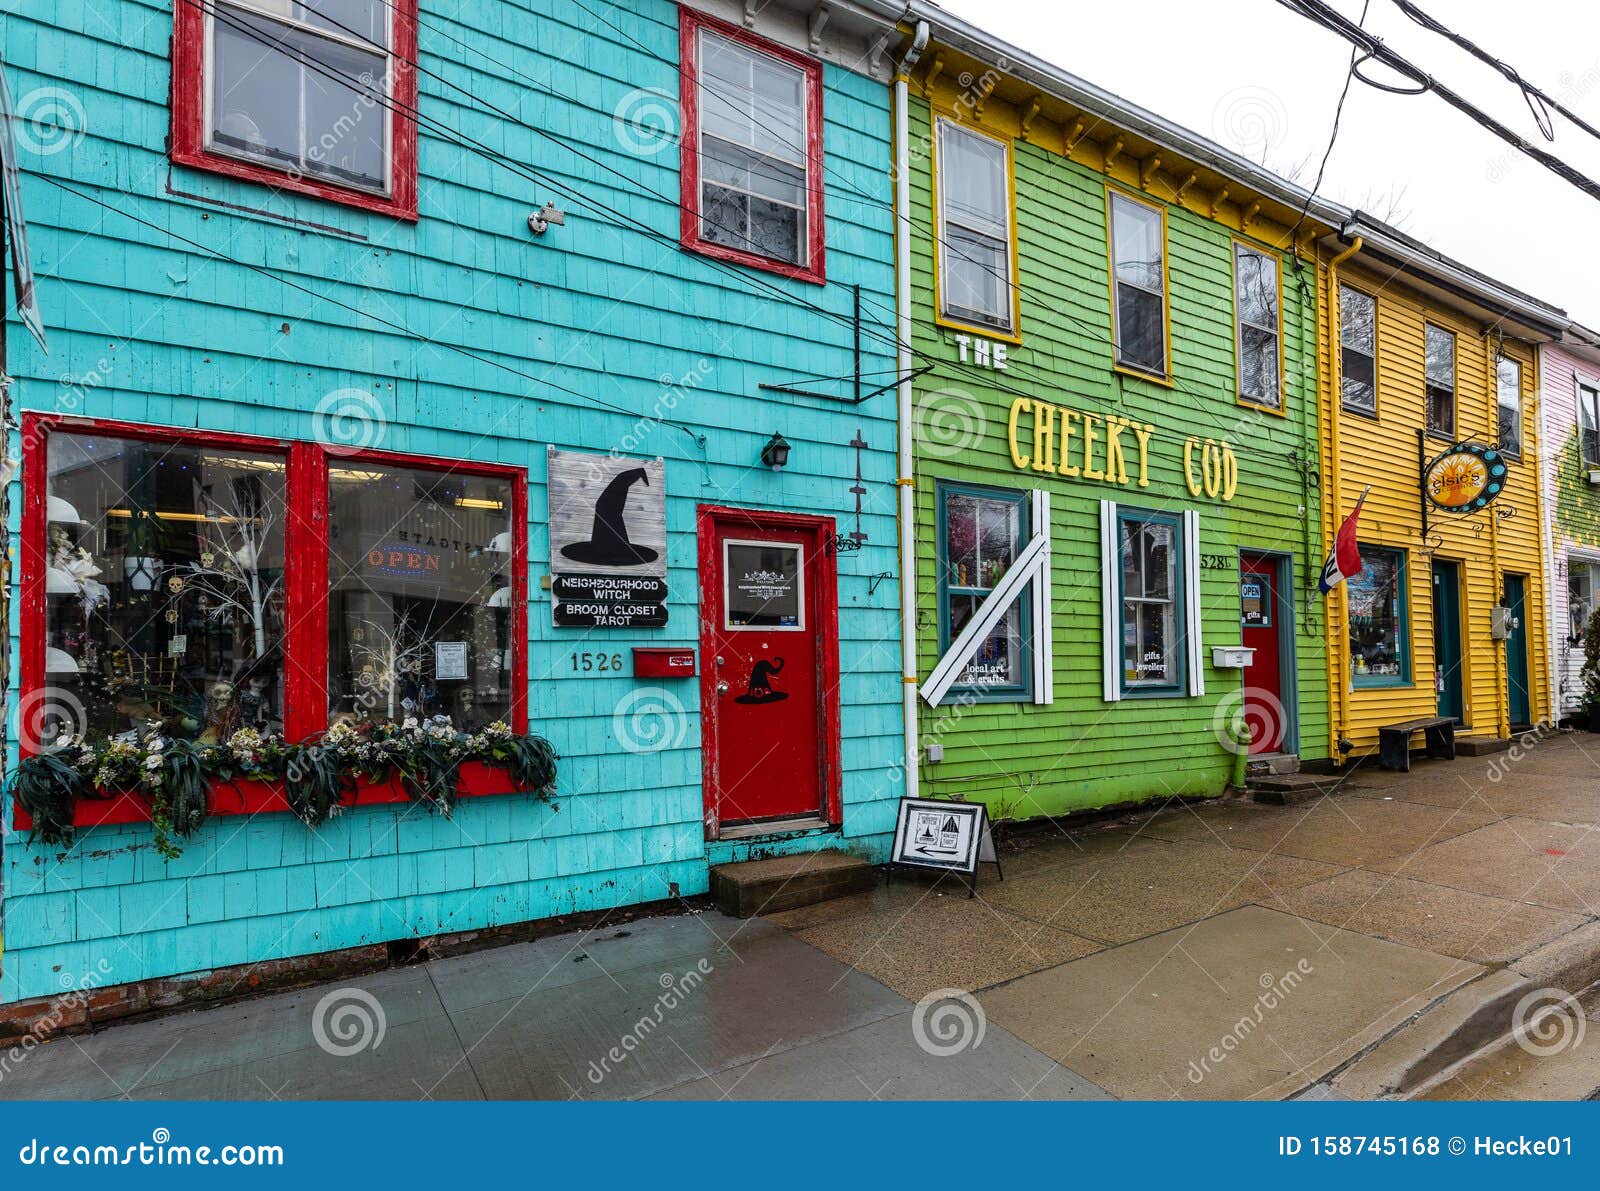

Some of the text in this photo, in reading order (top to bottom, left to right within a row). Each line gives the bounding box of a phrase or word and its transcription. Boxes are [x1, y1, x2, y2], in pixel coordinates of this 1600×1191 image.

[955, 334, 1008, 370] THE
[1008, 397, 1238, 501] CHEEKY COD
[368, 550, 441, 571] OPEN
[561, 578, 659, 590] NEIGHBOURHOOD
[593, 589, 631, 600] WITCH
[1243, 586, 1260, 597] OPEN
[566, 604, 658, 616] BROOM CLOSET
[594, 615, 632, 626] TAROT
[571, 652, 623, 672] 1526
[1144, 651, 1161, 662] gifts
[966, 663, 1005, 673] local art
[978, 674, 1005, 684] crafts
